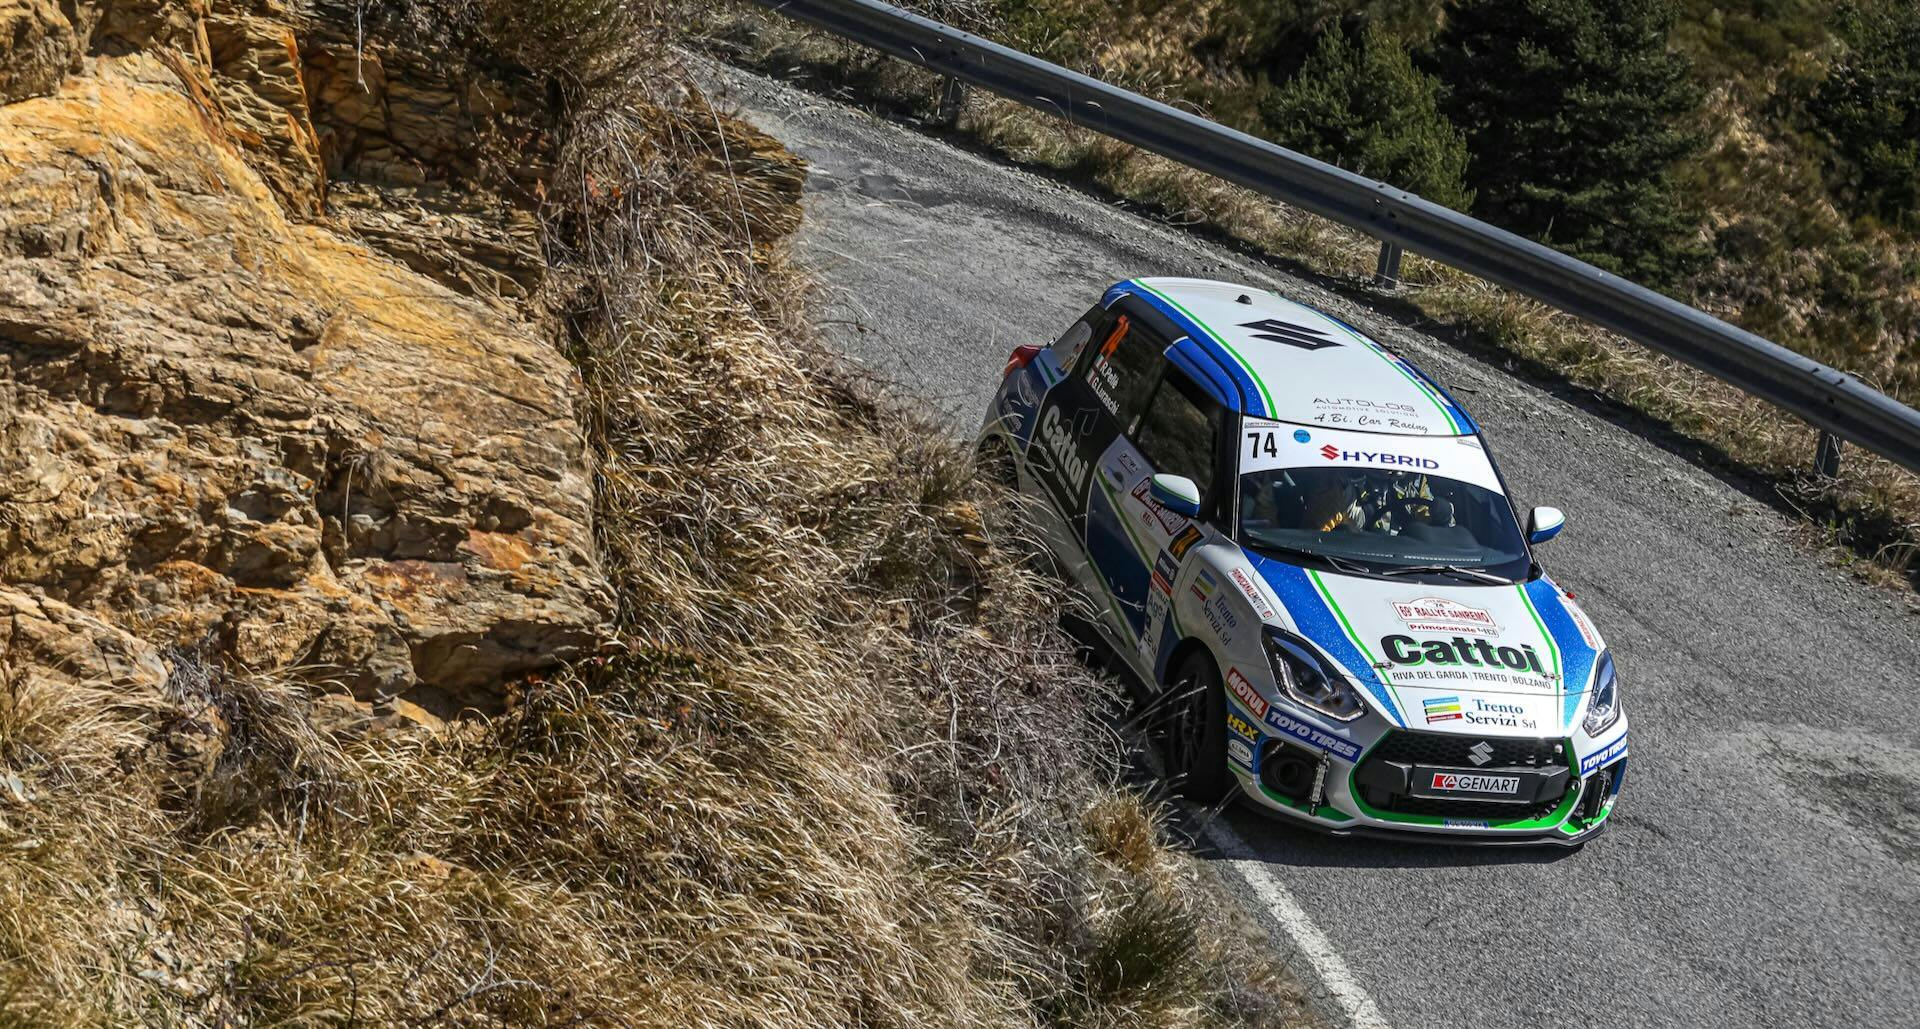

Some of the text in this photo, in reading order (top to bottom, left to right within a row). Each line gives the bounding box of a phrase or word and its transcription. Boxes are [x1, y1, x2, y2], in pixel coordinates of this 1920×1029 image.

[1313, 397, 1415, 412] AUTOLOG
[1358, 415, 1382, 425] Car
[1388, 418, 1428, 434] Racing
[1043, 405, 1089, 495] Cattoi
[1247, 432, 1278, 459] 74
[1342, 451, 1439, 469] HYBRID
[1203, 600, 1223, 634] Servizi
[1215, 593, 1237, 628] Trento
[1414, 607, 1447, 618] RALLYE
[1447, 610, 1490, 623] SANREMO
[1409, 624, 1477, 633] Primocanale
[1380, 634, 1543, 674] Cattoi
[1392, 671, 1551, 689] RIVA DEL GARDA TRENTO BOLZANO
[1228, 672, 1265, 714] MOTUL
[1472, 699, 1523, 715] Trento
[1227, 713, 1259, 740] HRX
[1465, 712, 1537, 729] Servizi Srl
[1270, 711, 1310, 737] TOYO
[1310, 732, 1357, 757] TIRES
[1583, 750, 1608, 770] TOYO
